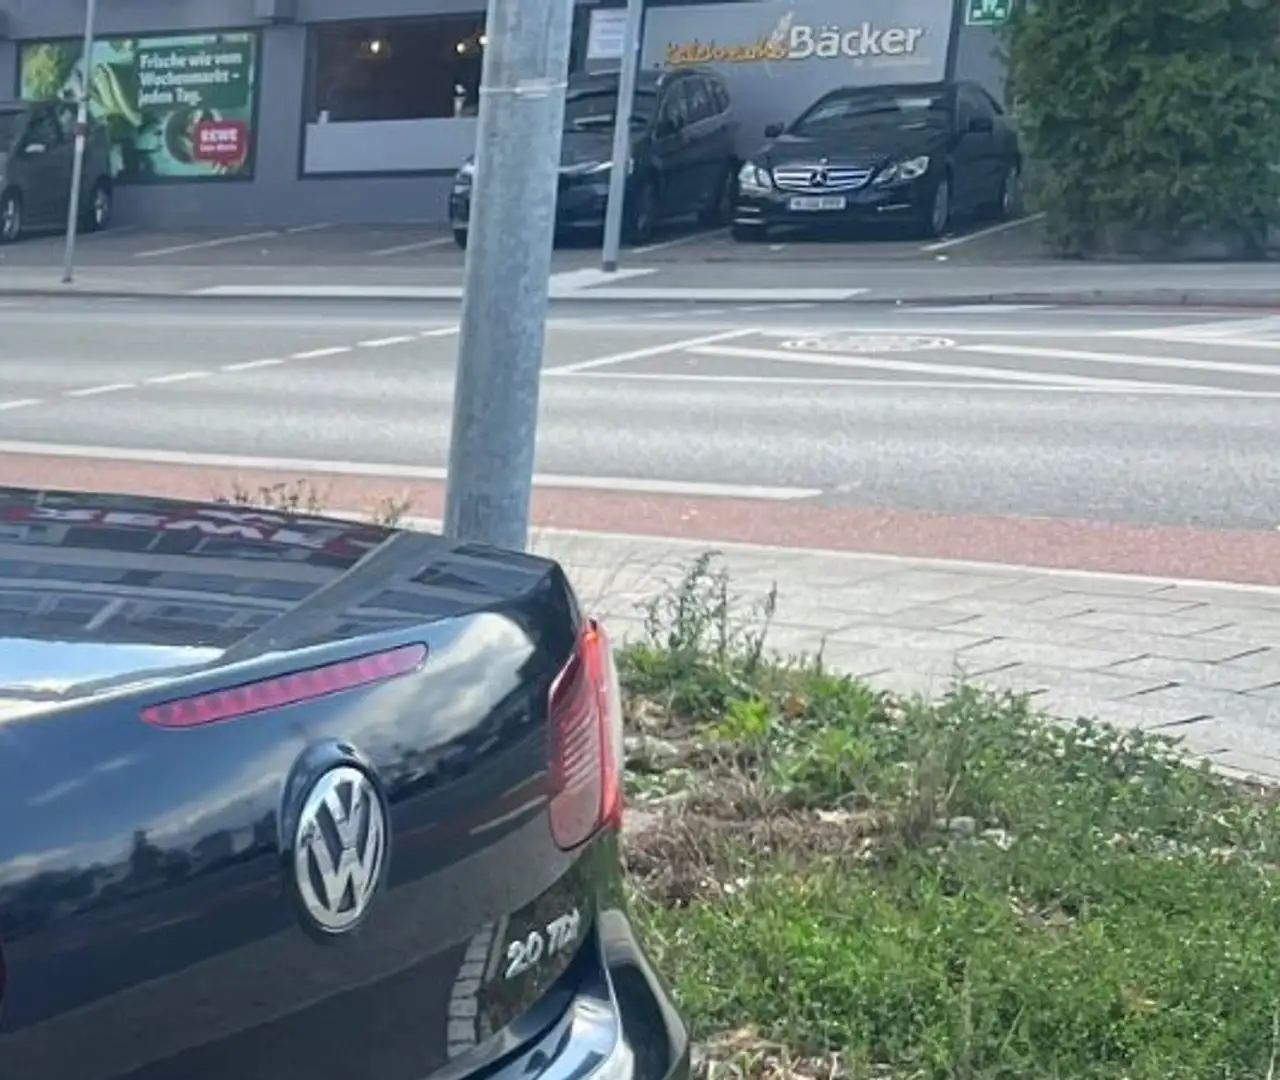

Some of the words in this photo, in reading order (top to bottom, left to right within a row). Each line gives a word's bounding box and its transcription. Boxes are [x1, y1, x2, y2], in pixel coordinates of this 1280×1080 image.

[789, 22, 924, 59] Bäcker
[139, 52, 186, 68] Frische
[188, 51, 212, 67] wie
[214, 52, 242, 65] vom
[139, 69, 229, 87] Wochenmarkt
[200, 128, 238, 141] REWE
